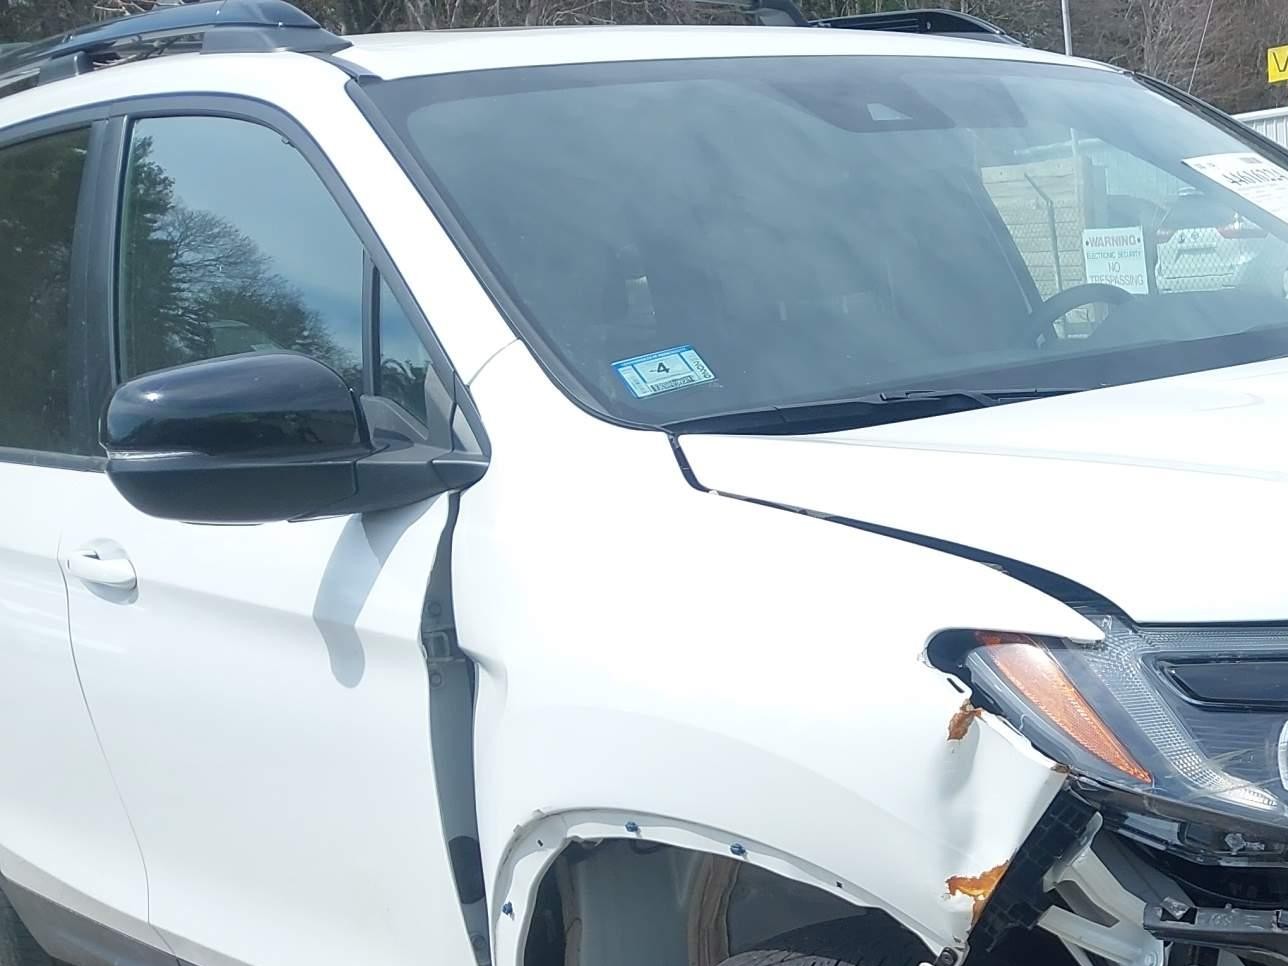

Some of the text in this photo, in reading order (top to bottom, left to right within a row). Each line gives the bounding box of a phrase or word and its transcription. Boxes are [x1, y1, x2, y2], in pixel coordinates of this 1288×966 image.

[1088, 234, 1137, 248] WARNING
[1107, 261, 1121, 273] NO
[1089, 273, 1144, 287] TRESPASSING
